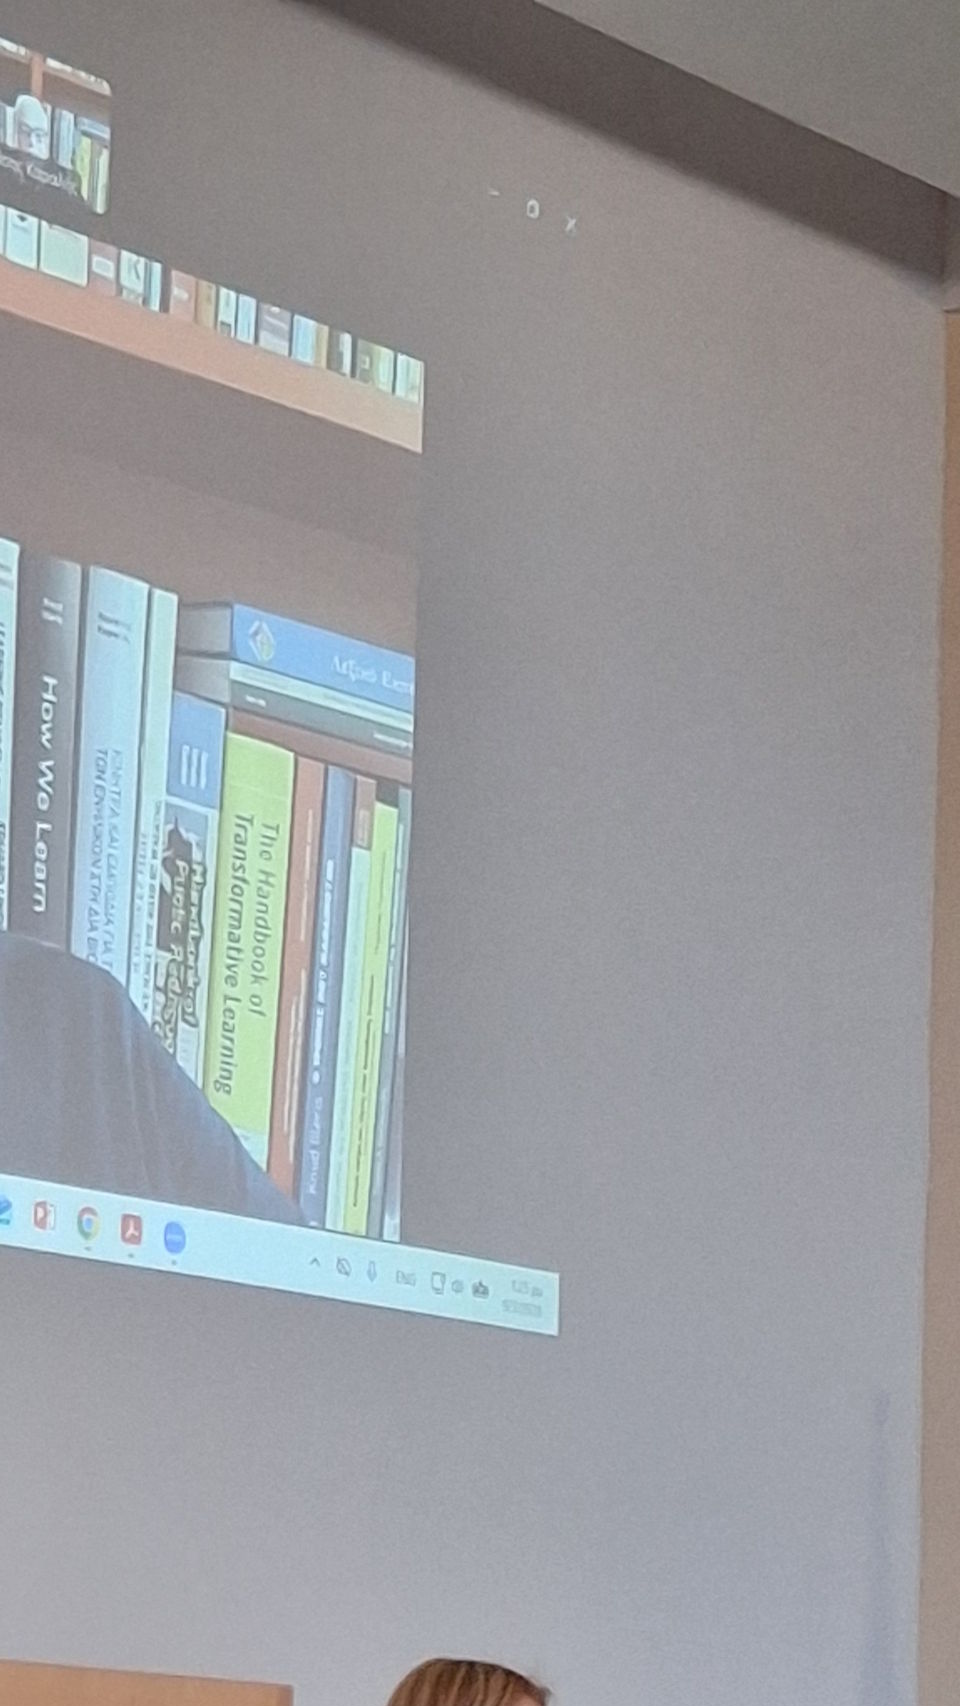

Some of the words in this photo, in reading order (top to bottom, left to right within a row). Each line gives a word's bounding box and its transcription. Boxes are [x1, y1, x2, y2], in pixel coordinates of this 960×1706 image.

[37, 674, 59, 750] How
[35, 758, 57, 812] We
[30, 820, 53, 914] Learn
[259, 822, 280, 861] The
[222, 813, 255, 990] Transformative
[249, 872, 278, 987] Handbook
[213, 992, 242, 1096] Learning
[248, 995, 268, 1019] of
